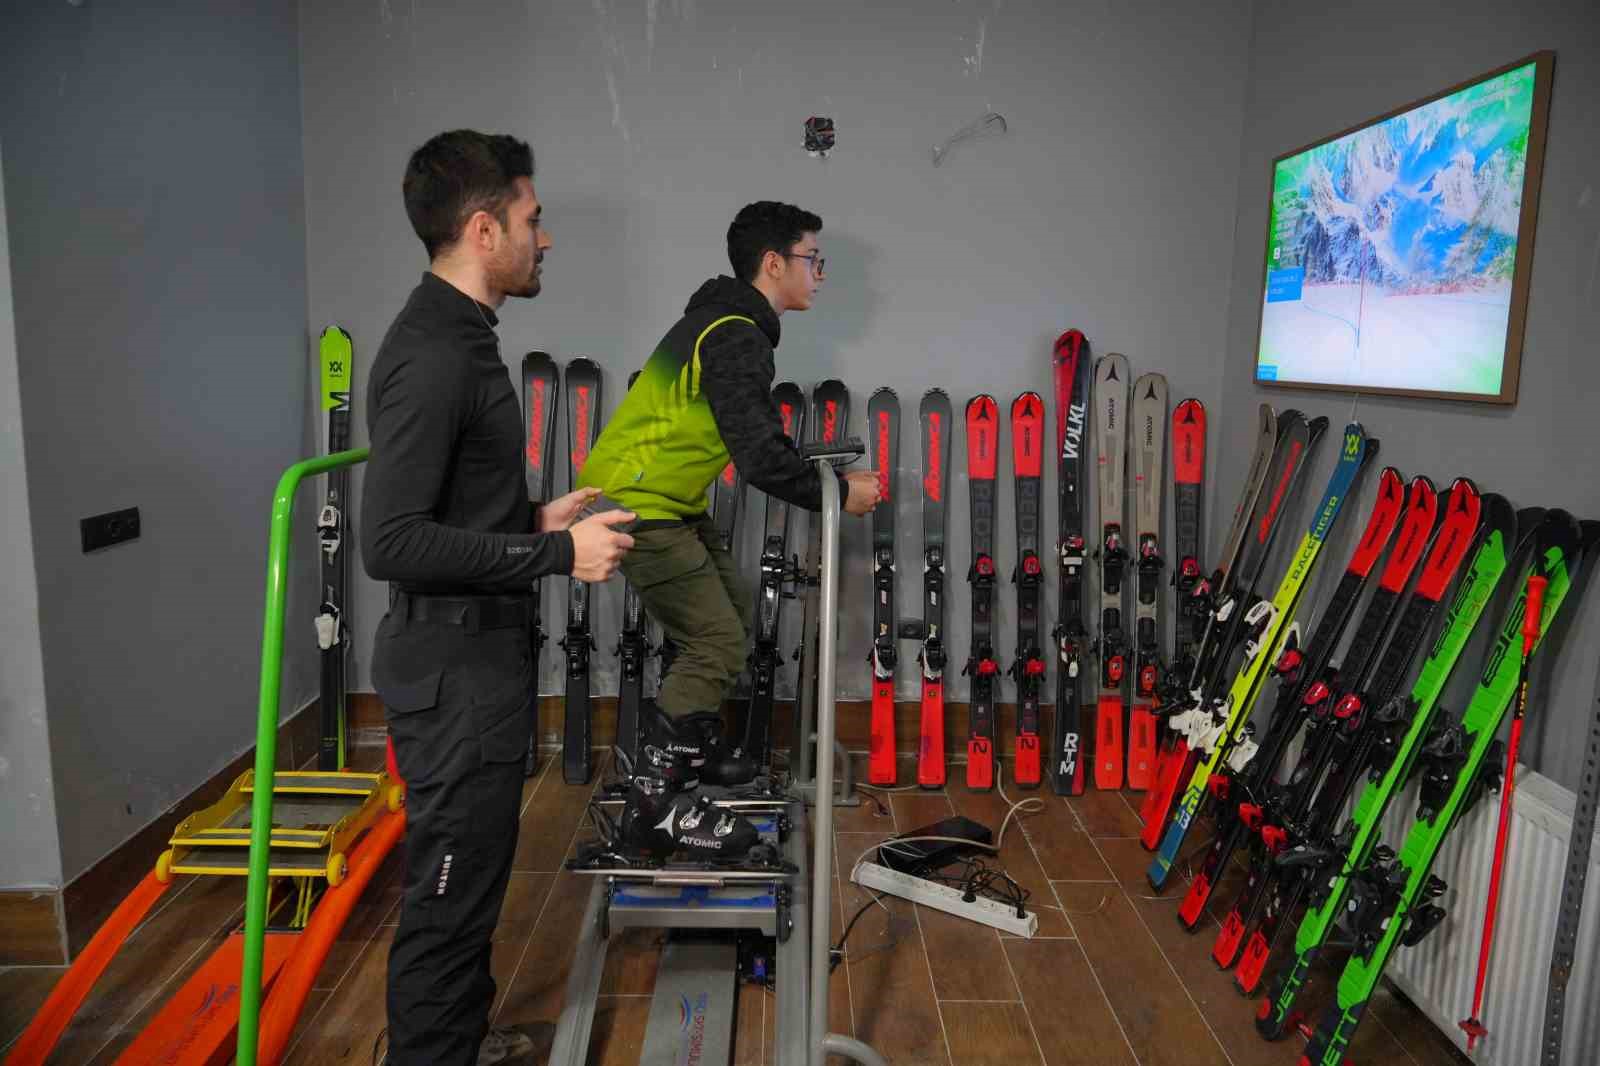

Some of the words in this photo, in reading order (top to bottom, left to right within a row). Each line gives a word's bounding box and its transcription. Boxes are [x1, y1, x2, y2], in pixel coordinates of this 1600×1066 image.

[1108, 397, 1116, 430] ATOMIC
[1059, 732, 1078, 775] RTM
[680, 835, 722, 849] ATOMIC
